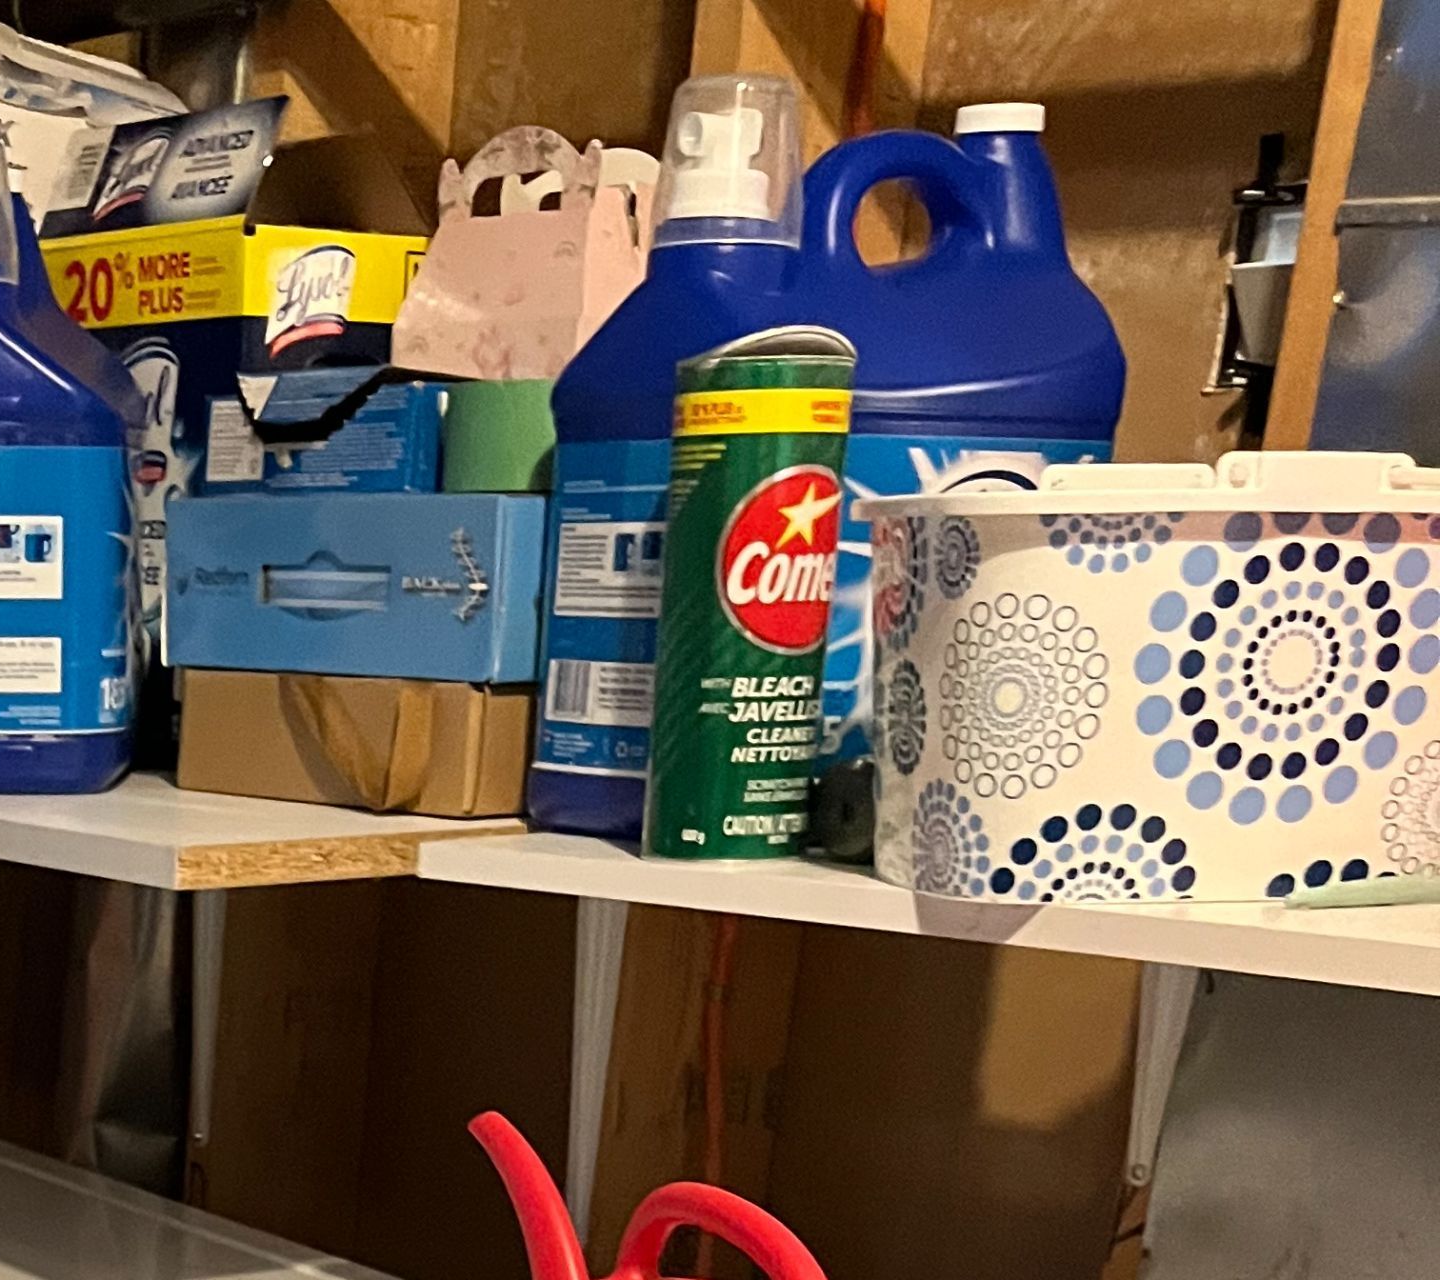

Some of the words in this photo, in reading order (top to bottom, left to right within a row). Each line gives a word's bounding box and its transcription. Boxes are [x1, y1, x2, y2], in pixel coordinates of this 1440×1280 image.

[64, 252, 135, 322] 20%
[138, 252, 190, 282] MORE
[138, 287, 184, 316] PLUS
[276, 256, 350, 327] Lysol
[731, 675, 815, 698] BLEACH
